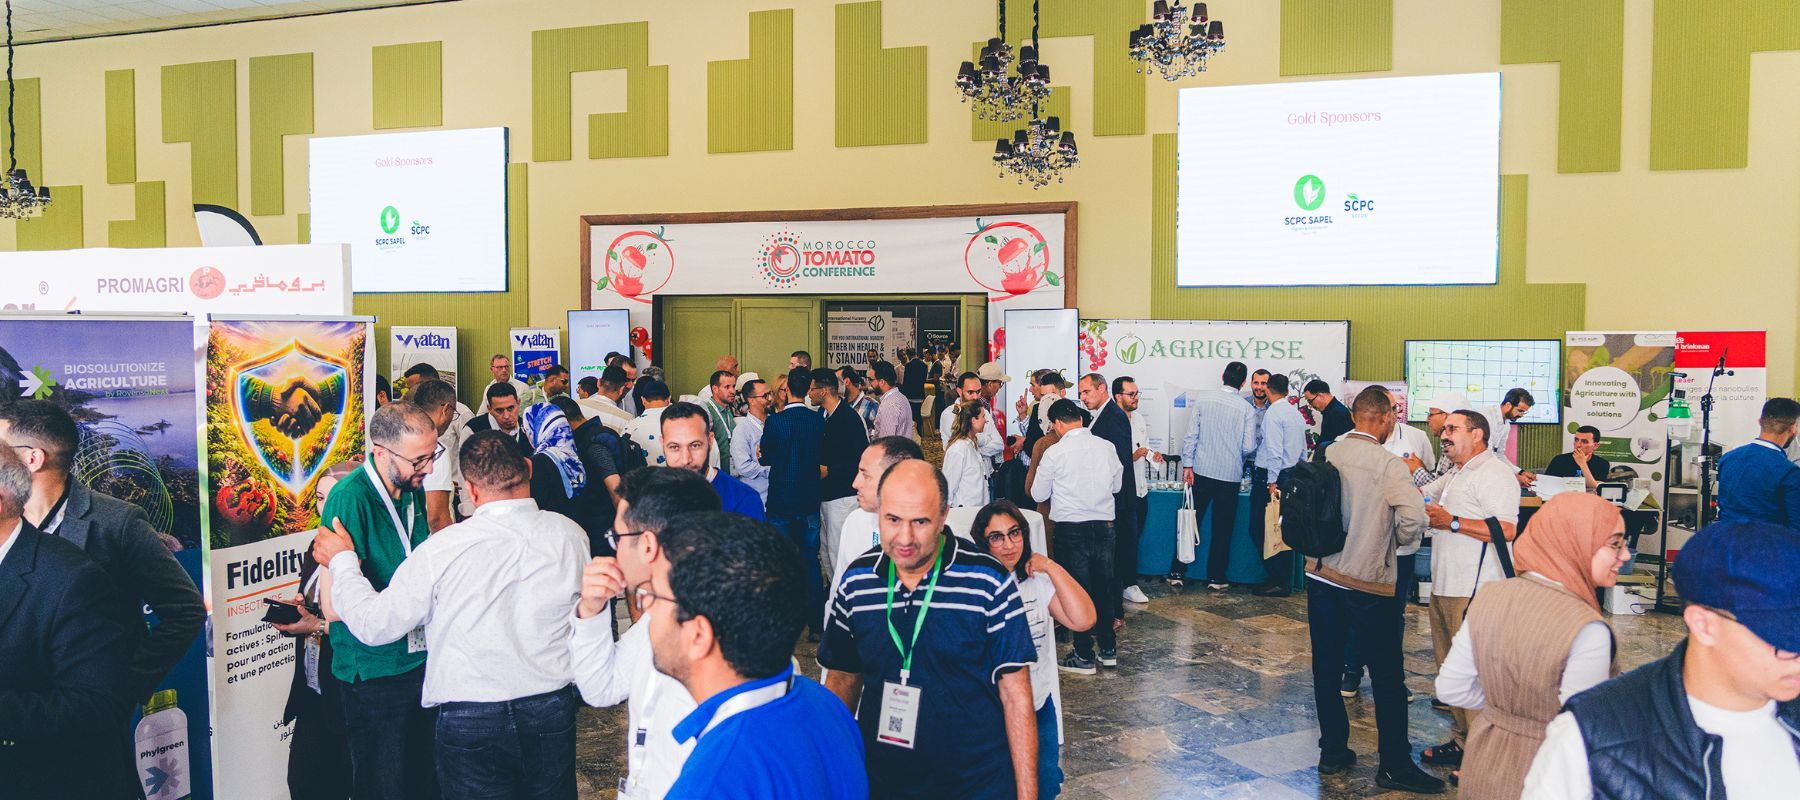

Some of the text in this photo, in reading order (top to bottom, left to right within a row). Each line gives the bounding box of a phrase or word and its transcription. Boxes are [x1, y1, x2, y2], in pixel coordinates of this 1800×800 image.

[1287, 110, 1382, 127] Gold Sponsors
[375, 156, 433, 168] Gold Sponsors
[1344, 199, 1375, 212] SCPC
[1284, 215, 1333, 226] SCPC SAPEL
[411, 225, 430, 235] SCPC
[375, 237, 405, 246] SCPC SAPEL
[803, 240, 876, 250] MOROCCO
[802, 249, 876, 266] TOMATO
[802, 266, 876, 277] CONFERENCE
[97, 277, 184, 294] PROMAGRI
[413, 332, 451, 349] vatan
[527, 331, 555, 349] vatan
[829, 343, 848, 351] RTHER
[849, 343, 856, 351] IN
[1149, 337, 1303, 359] AGRIGYPSE
[836, 353, 885, 364] STANDAS
[64, 362, 166, 374] BIOSOLUTIONIZE
[64, 375, 167, 390] AGRICULTURE
[1585, 380, 1627, 388] Innovating
[227, 549, 306, 589] Fidelity
[225, 622, 273, 642] Formulatio
[226, 640, 260, 656] actives
[227, 642, 294, 672] pour une action
[227, 654, 296, 684] et une protectio
[140, 740, 185, 759] Phylgreen
